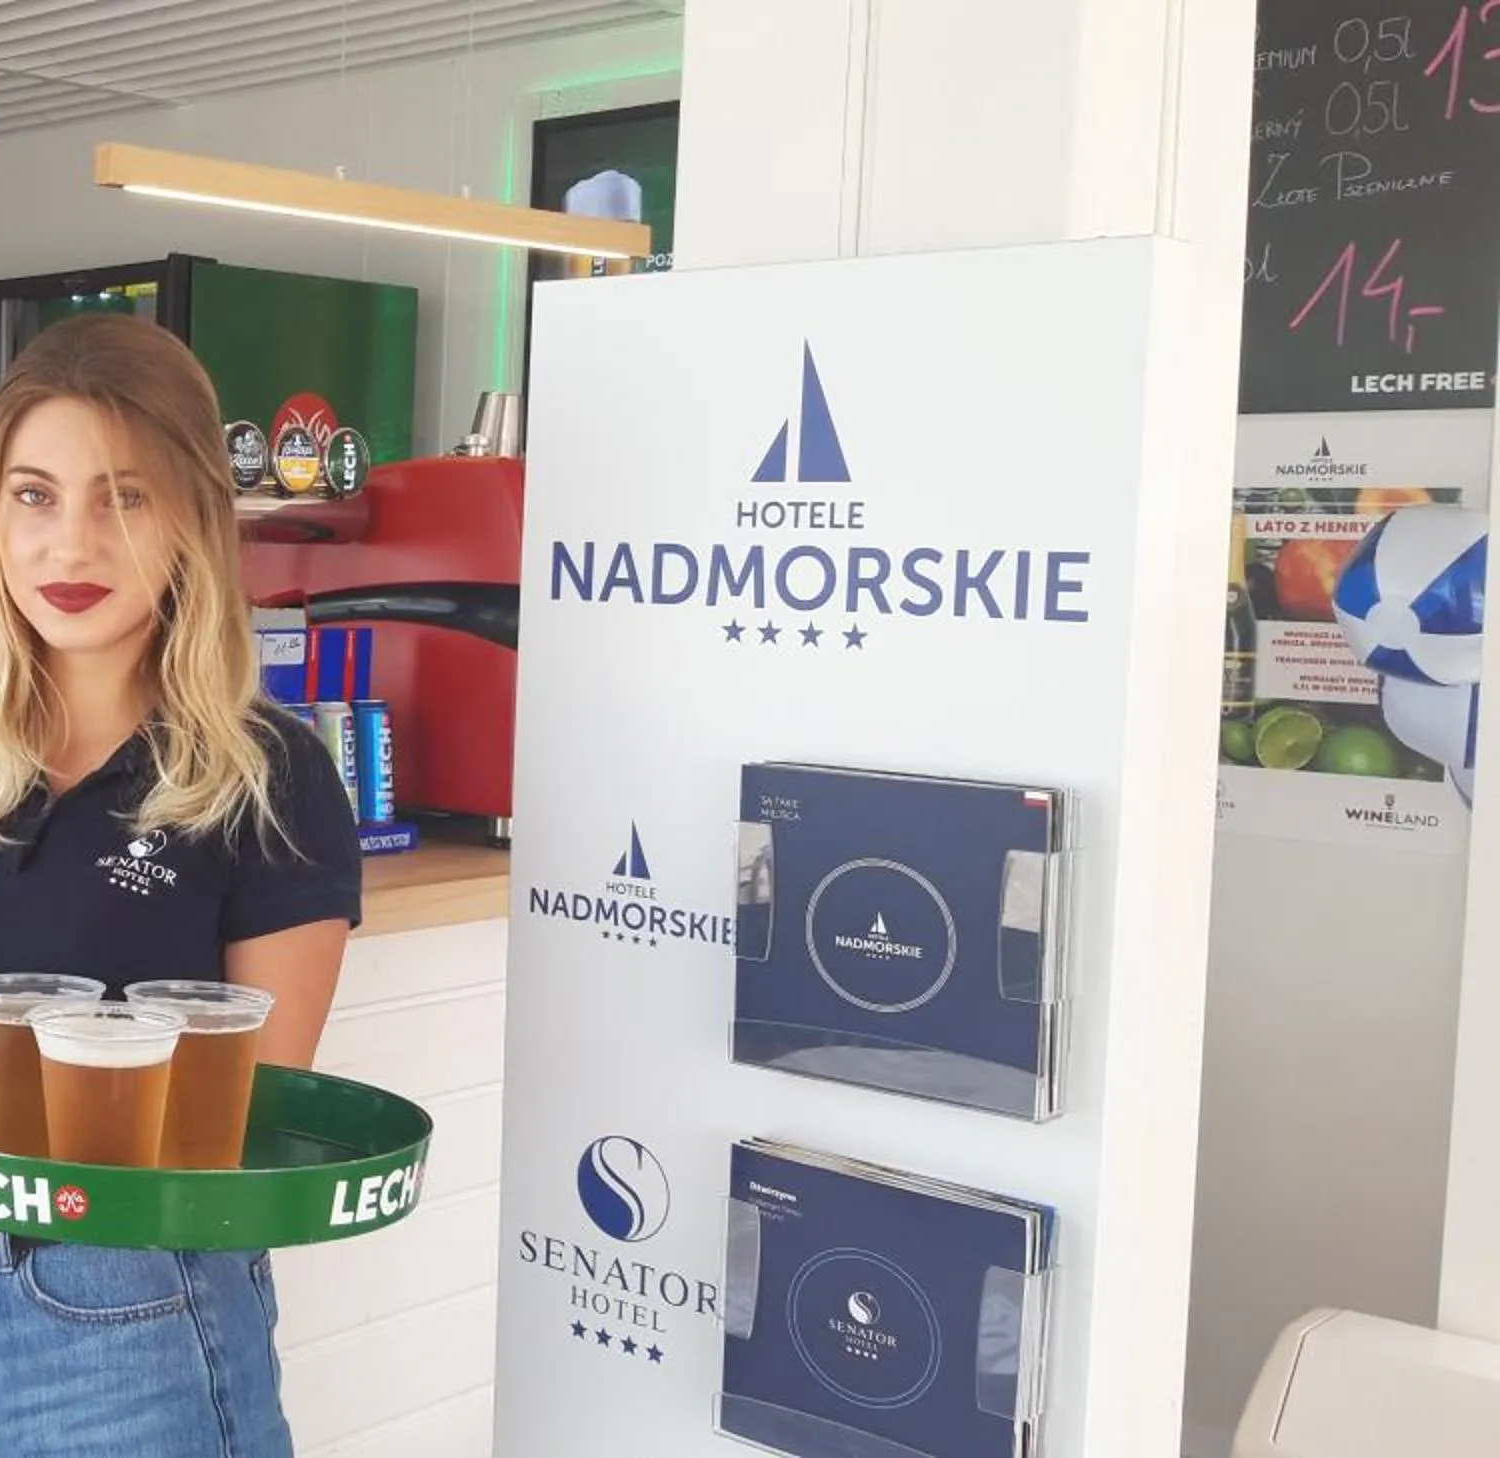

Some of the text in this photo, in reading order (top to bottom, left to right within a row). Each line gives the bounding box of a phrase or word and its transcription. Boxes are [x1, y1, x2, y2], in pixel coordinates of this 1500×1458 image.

[1254, 45, 1317, 70] EMIUM
[1350, 371, 1486, 393] LECH FREE
[344, 443, 357, 490] LECH
[1275, 463, 1368, 476] NADMORSKIE
[736, 501, 865, 529] HOTELE
[1255, 521, 1369, 534] LATO Z HENRY
[550, 540, 1092, 623] NADMORSKIE
[344, 728, 357, 779] LECH
[378, 726, 394, 790] LECH
[1345, 807, 1440, 828] WINELAND
[94, 855, 178, 887] SENATOR
[605, 881, 657, 900] HOTELE
[529, 887, 733, 945] NADMORSKIE
[835, 935, 923, 959] NADMORSKIE
[329, 1160, 420, 1227] LECH
[519, 1230, 718, 1314] SENATOR
[570, 1285, 666, 1333] HOTEL
[829, 1318, 897, 1348] SENATOR
